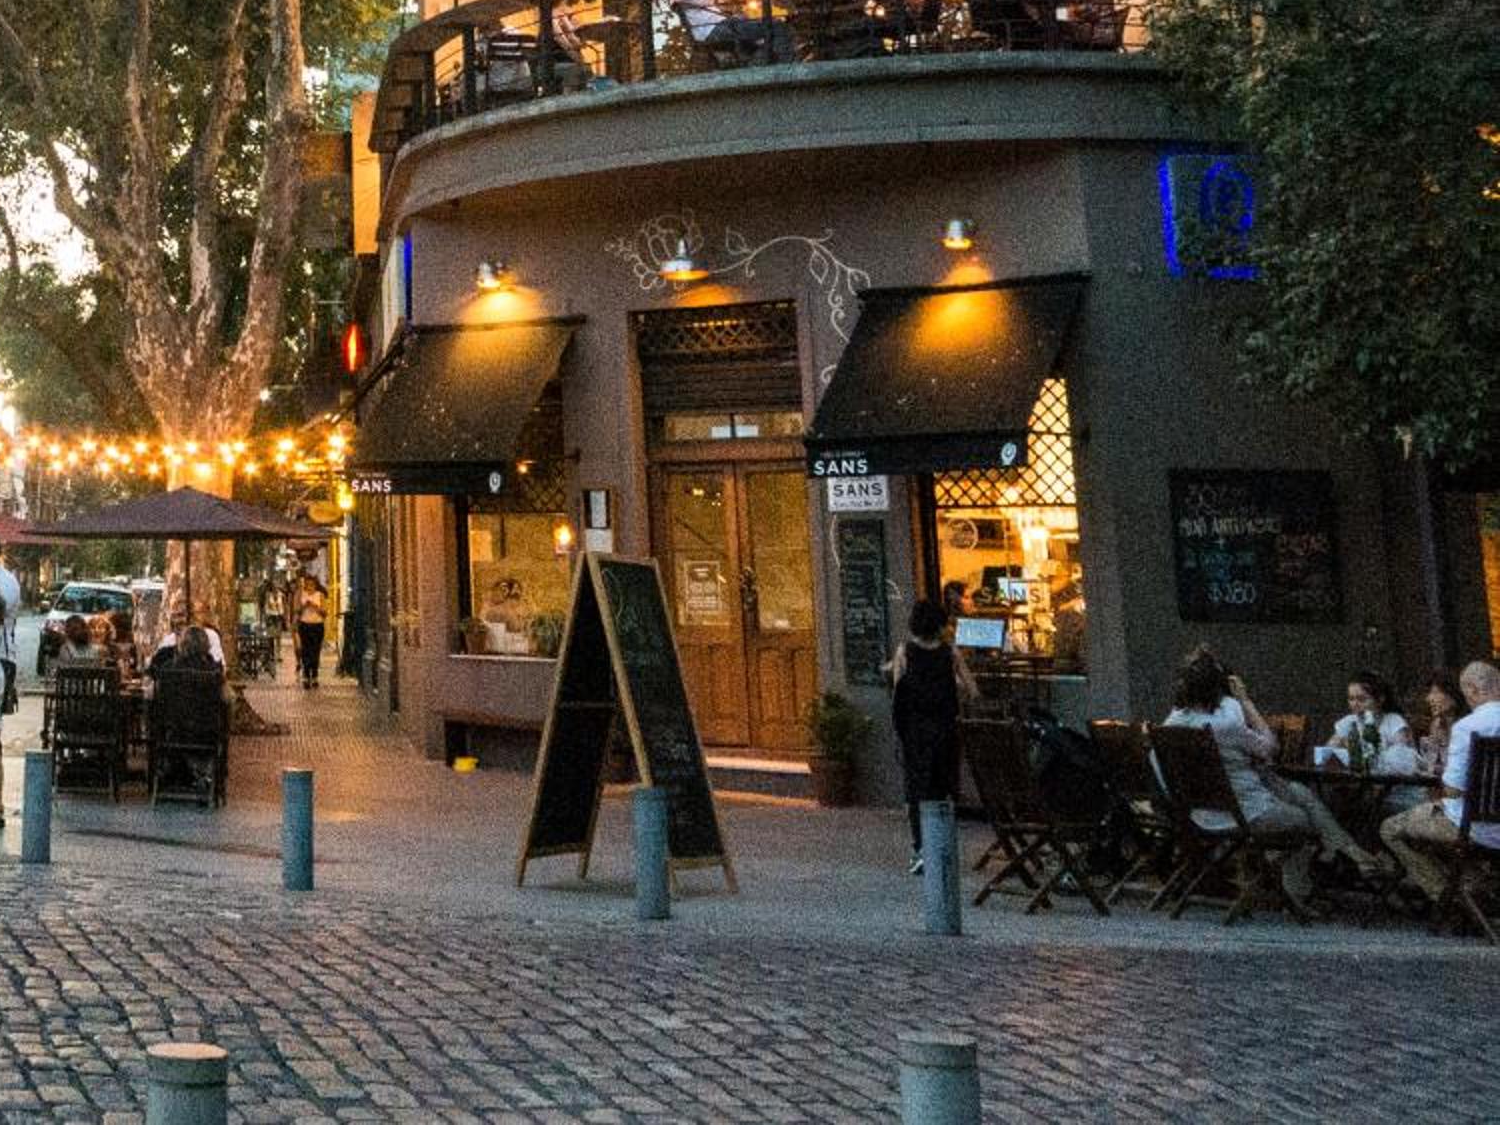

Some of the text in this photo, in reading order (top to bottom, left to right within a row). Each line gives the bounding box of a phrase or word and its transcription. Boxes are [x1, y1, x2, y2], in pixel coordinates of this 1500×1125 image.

[813, 459, 868, 475] SANS
[351, 479, 393, 494] SANS
[832, 482, 883, 497] SANS
[979, 586, 1042, 605] SANS
